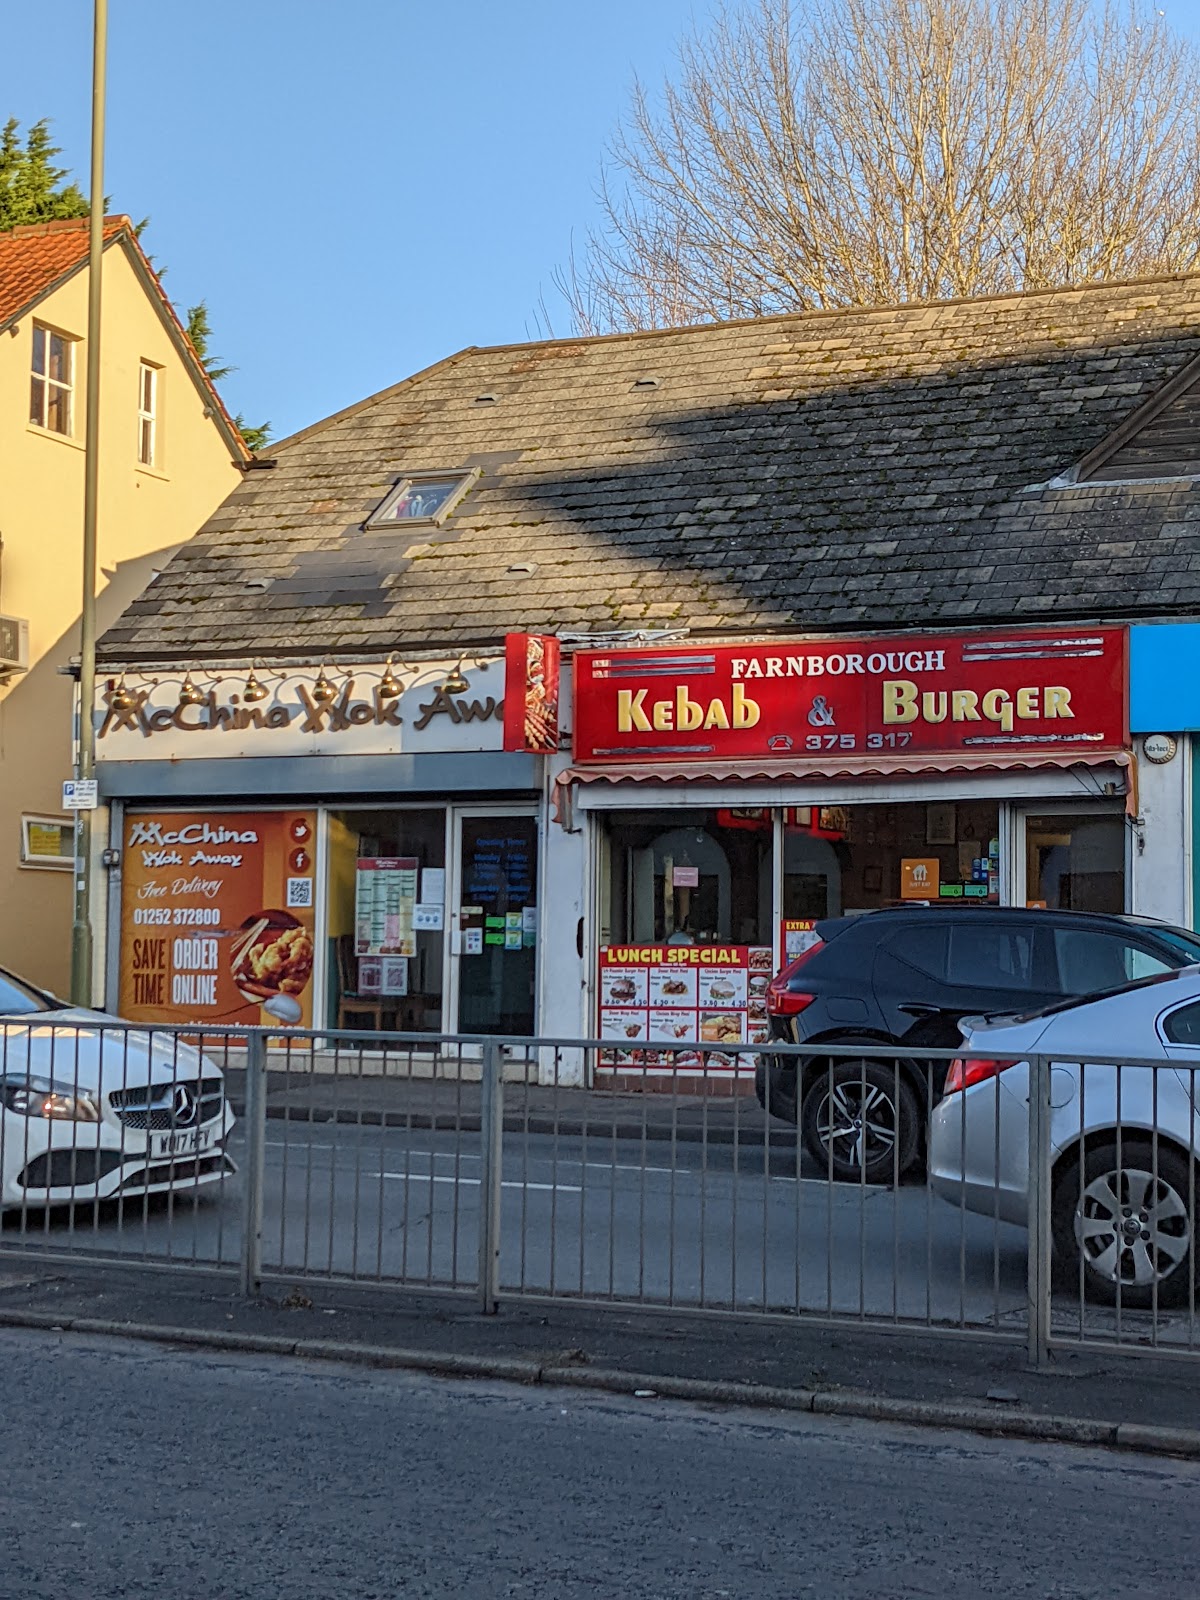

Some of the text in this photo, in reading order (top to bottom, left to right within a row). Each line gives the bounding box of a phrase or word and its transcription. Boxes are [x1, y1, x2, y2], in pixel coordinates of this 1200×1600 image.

[730, 650, 946, 679] FARNBOROUGH
[98, 688, 291, 739] McChina
[295, 679, 403, 733] Wok
[806, 694, 837, 727] &
[805, 732, 912, 750] 375 317
[66, 784, 74, 795] P
[128, 822, 258, 847] McChina
[141, 850, 243, 868] Wok Away
[137, 876, 224, 899] Free Delivery
[133, 908, 221, 925] 01252 372800
[786, 921, 811, 930] EXTRA
[133, 938, 219, 970] SAVE ORDER
[607, 948, 741, 964] LUNCH SPECIAL
[132, 974, 219, 1006] TIME ONLINE
